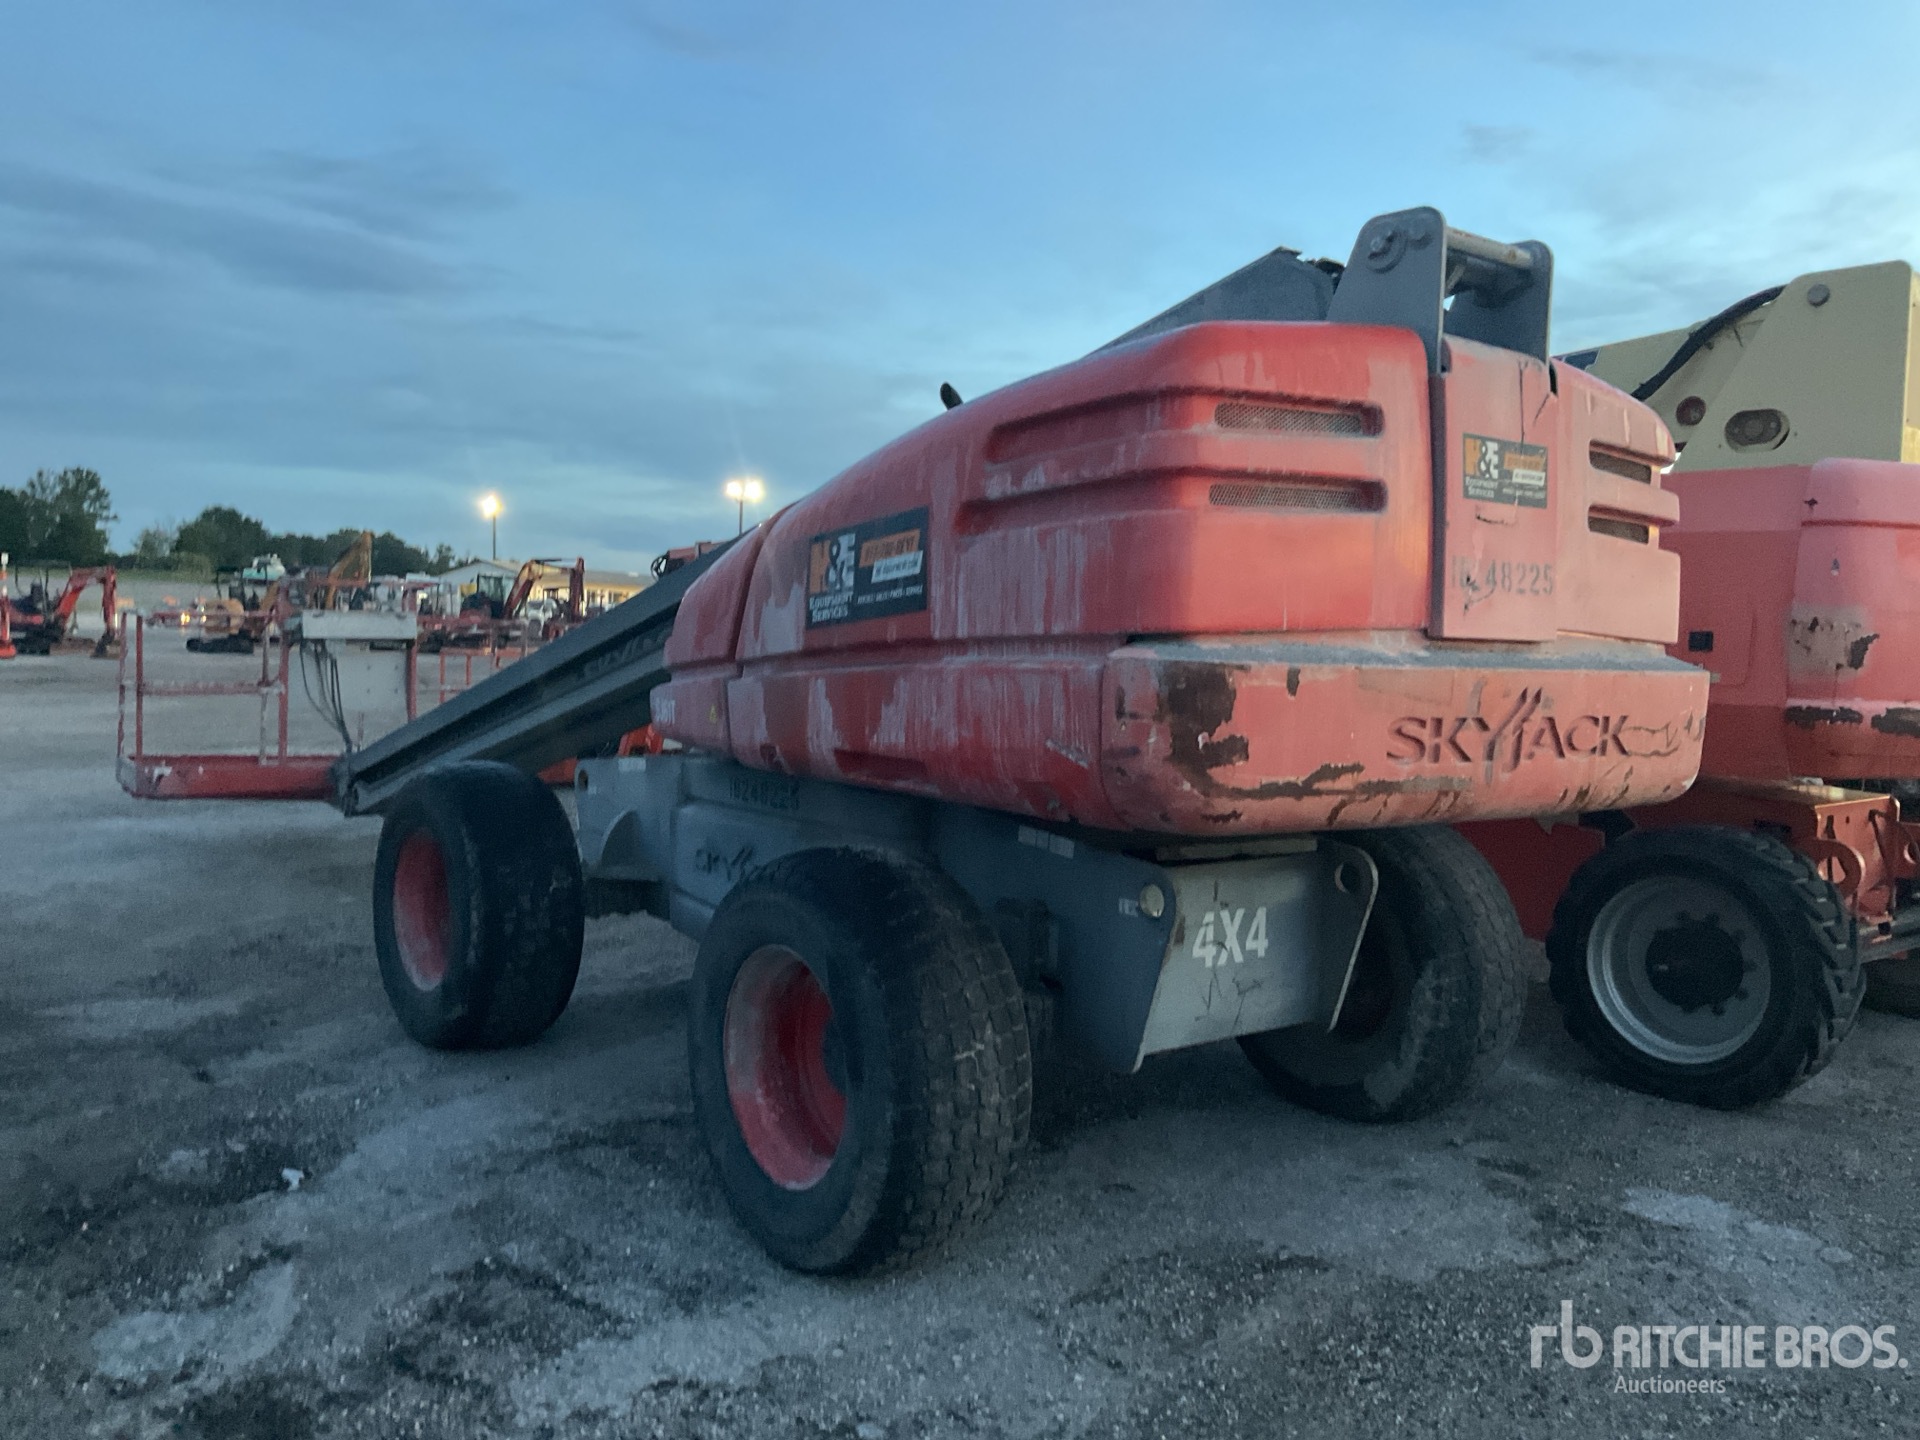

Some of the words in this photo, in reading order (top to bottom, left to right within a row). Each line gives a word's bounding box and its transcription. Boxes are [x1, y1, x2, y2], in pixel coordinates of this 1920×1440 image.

[1464, 438, 1499, 480] H&E
[809, 532, 856, 595] H&E
[809, 591, 853, 611] EQUIPMENT
[812, 604, 849, 623] SERVICES
[1387, 687, 1631, 774] SKYJACK
[1192, 906, 1269, 968] 4X4
